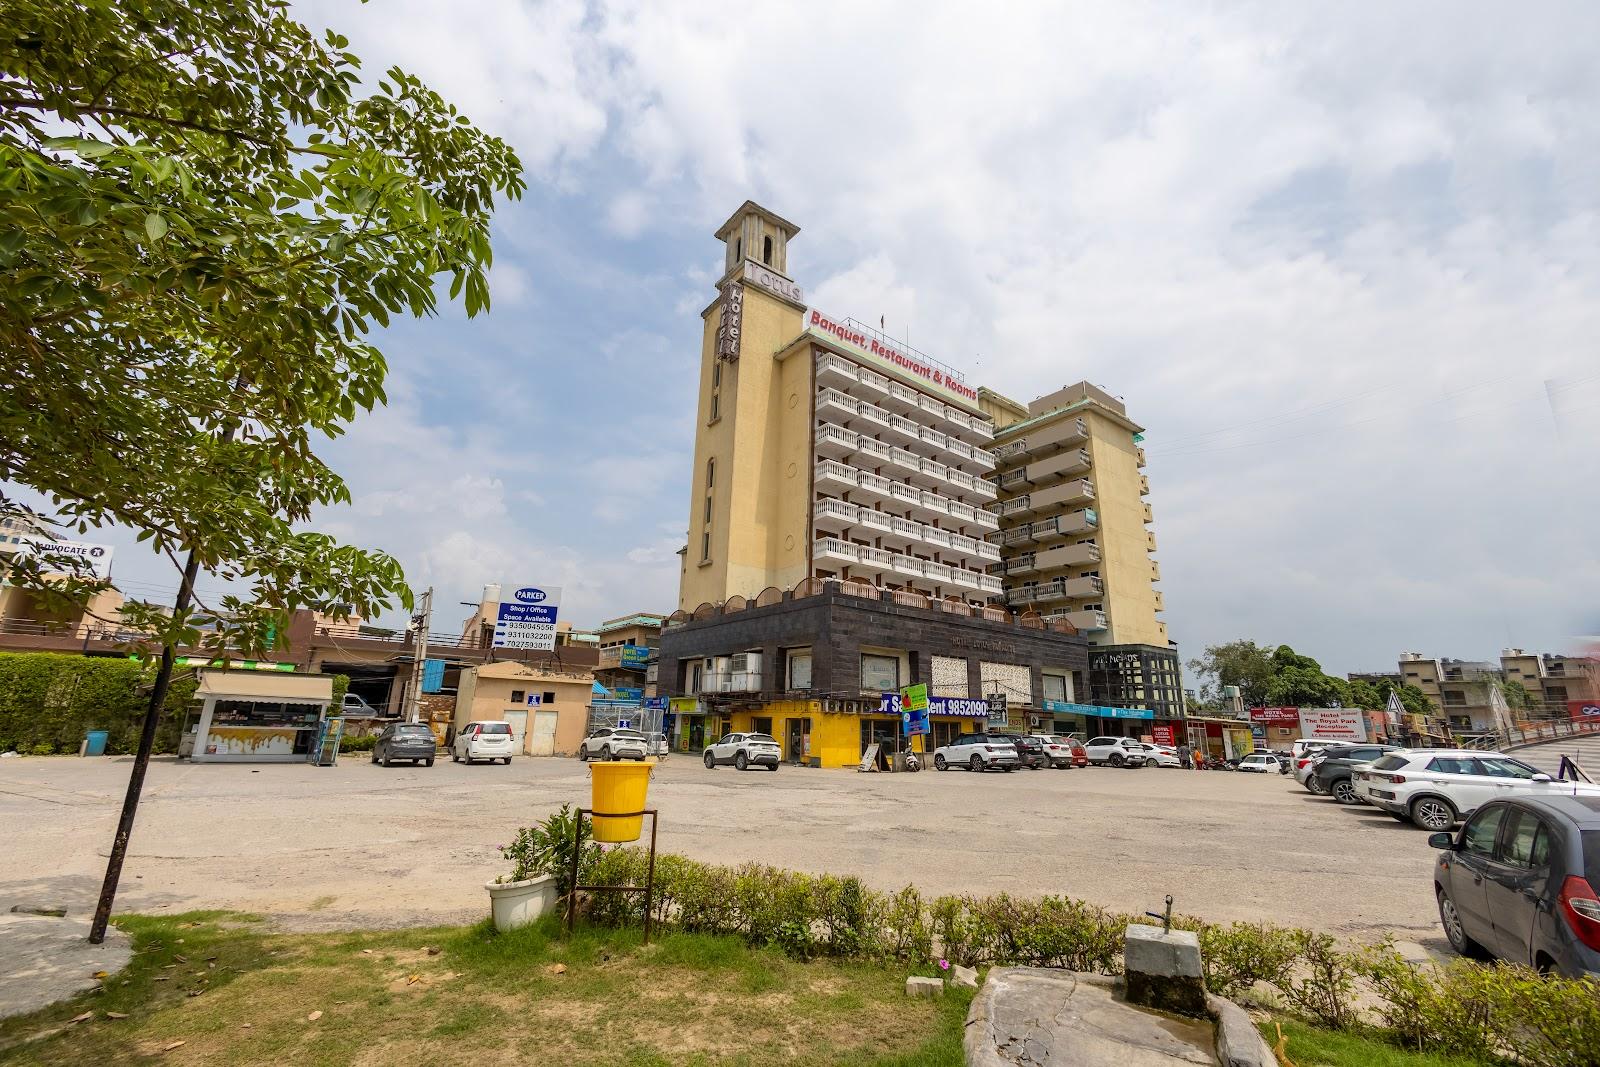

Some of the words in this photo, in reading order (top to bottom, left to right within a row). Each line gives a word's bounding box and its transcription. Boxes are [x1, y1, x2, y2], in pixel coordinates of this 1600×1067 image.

[728, 288, 743, 353] Hotel
[810, 309, 868, 350] Banquet,
[871, 338, 931, 380] Restaurant
[933, 370, 943, 385] &
[945, 375, 977, 401] Rooms
[516, 590, 545, 600] PARKER
[509, 605, 526, 614] Shop
[529, 606, 548, 614] Office
[503, 613, 523, 621] Space
[524, 615, 552, 623] Available
[948, 699, 989, 717] 9852090
